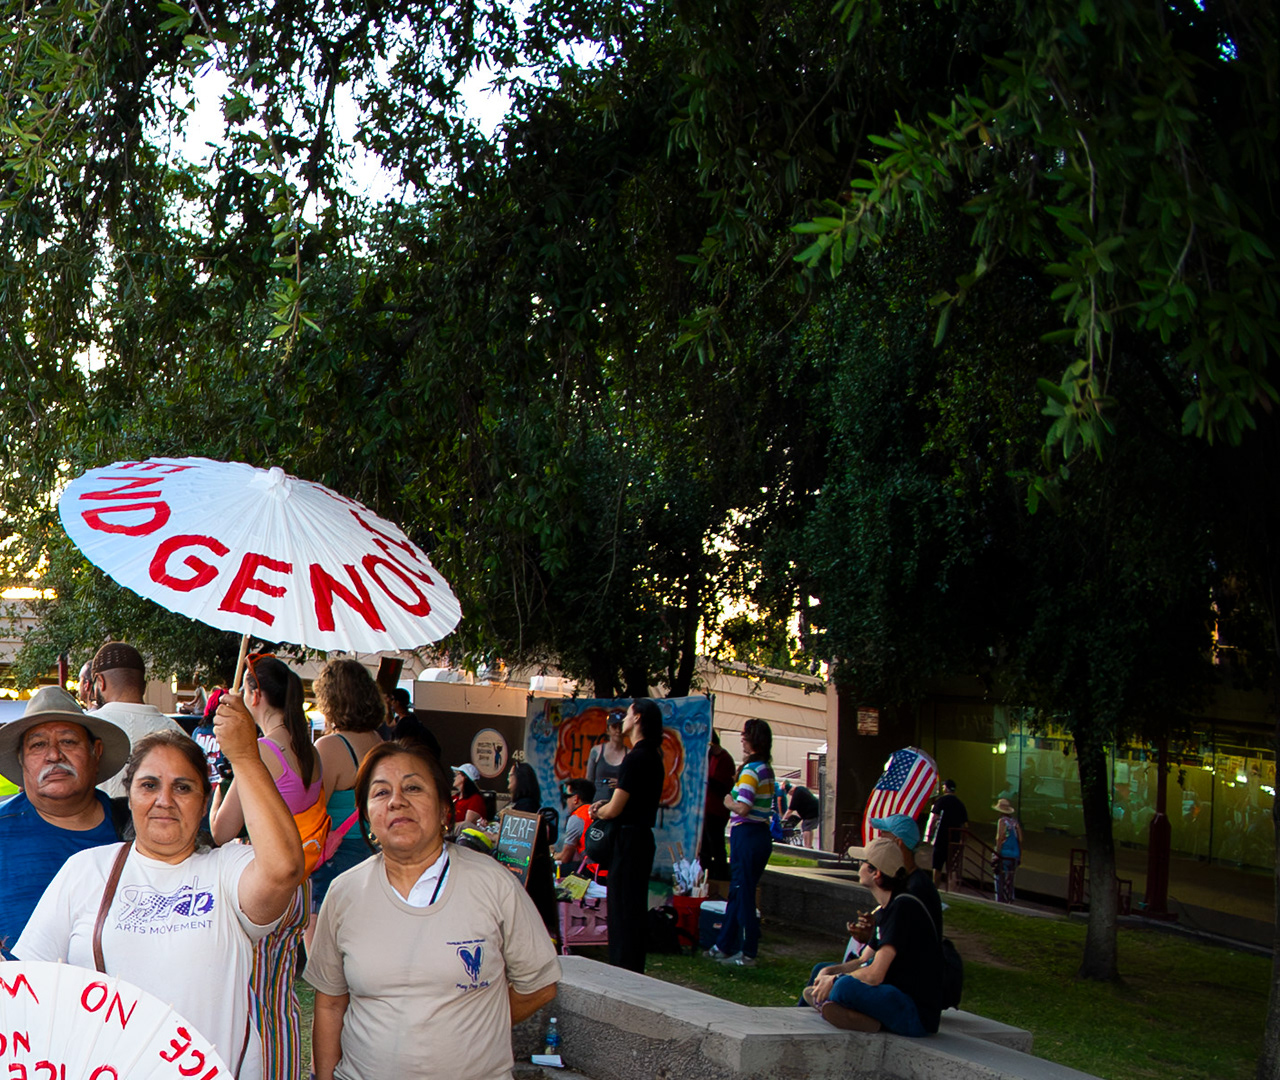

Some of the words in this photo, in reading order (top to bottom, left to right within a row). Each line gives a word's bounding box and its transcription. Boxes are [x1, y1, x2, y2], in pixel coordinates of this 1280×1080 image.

[502, 816, 536, 840] AZRF
[115, 921, 147, 934] ARTS
[149, 919, 214, 935] MOVEMENT
[80, 981, 138, 1030] NO
